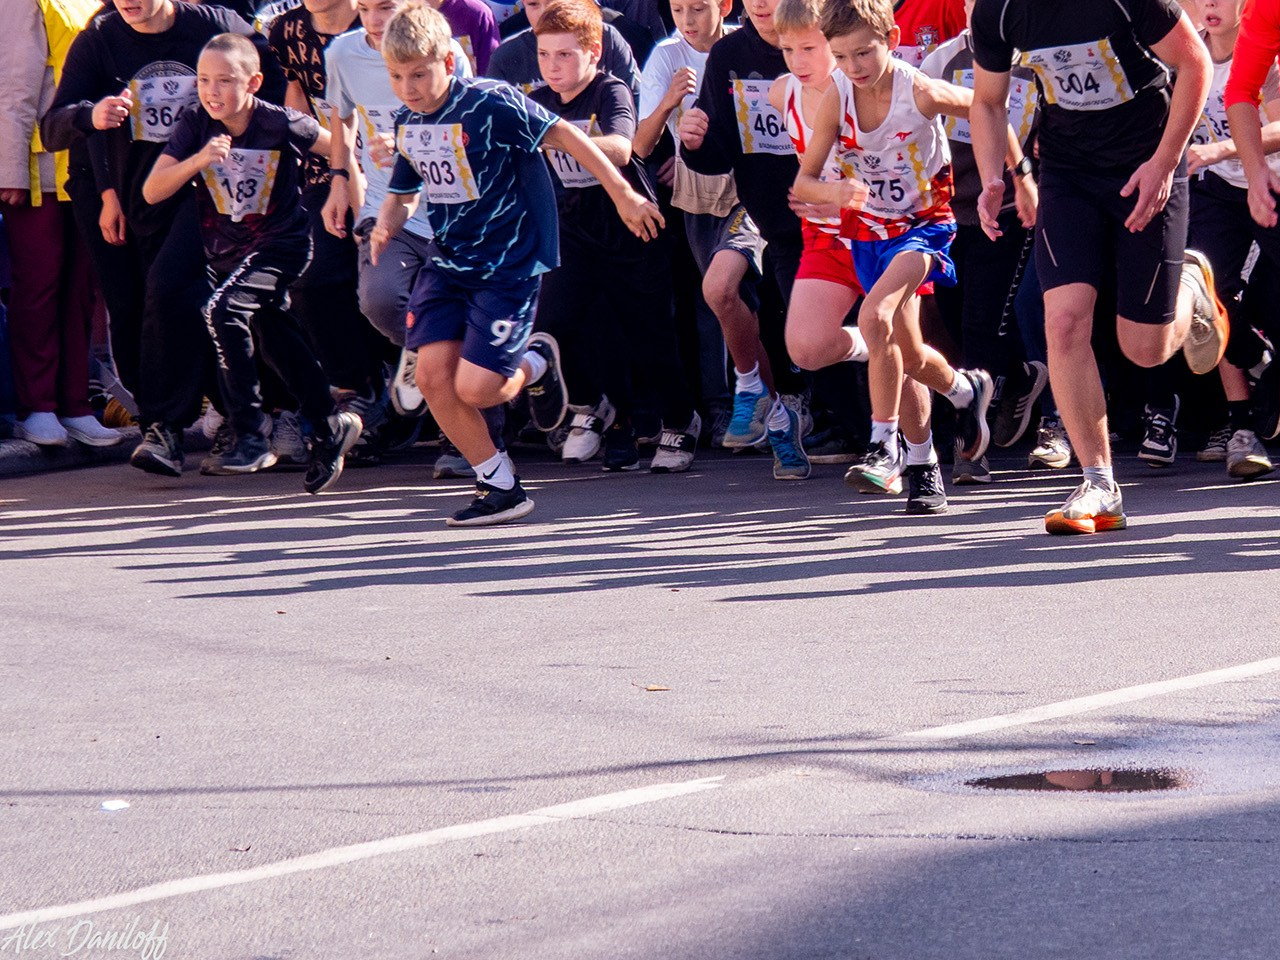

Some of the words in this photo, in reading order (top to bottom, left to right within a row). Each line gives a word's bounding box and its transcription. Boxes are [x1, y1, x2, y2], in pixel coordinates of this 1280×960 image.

[221, 178, 257, 203] 183
[489, 319, 512, 347] 9
[660, 431, 685, 448] NIKE
